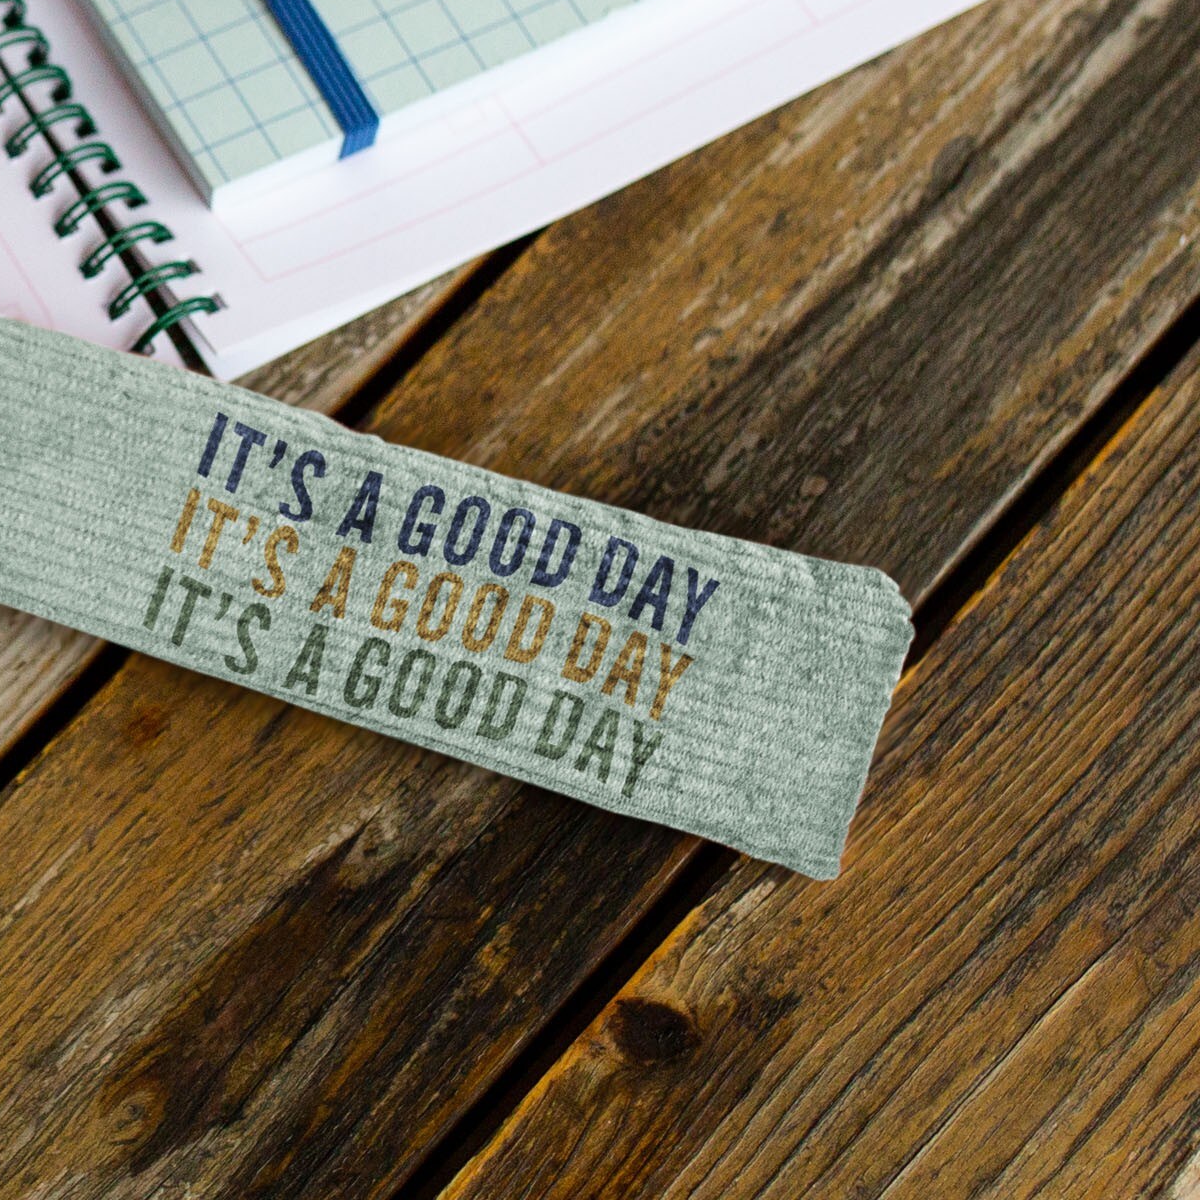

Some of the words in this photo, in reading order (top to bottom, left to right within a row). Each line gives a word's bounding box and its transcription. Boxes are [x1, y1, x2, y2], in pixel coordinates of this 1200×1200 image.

[169, 487, 299, 599] IT'S
[309, 547, 358, 620] A
[370, 561, 556, 665] GOOD
[561, 611, 694, 722] DAY
[196, 412, 326, 523] IT'S
[335, 471, 384, 544] A
[397, 485, 582, 588] GOOD
[587, 536, 720, 646] DAY
[142, 565, 271, 675] IT'S
[281, 623, 329, 696] A
[342, 637, 529, 742] GOOD
[533, 689, 664, 799] DAY
